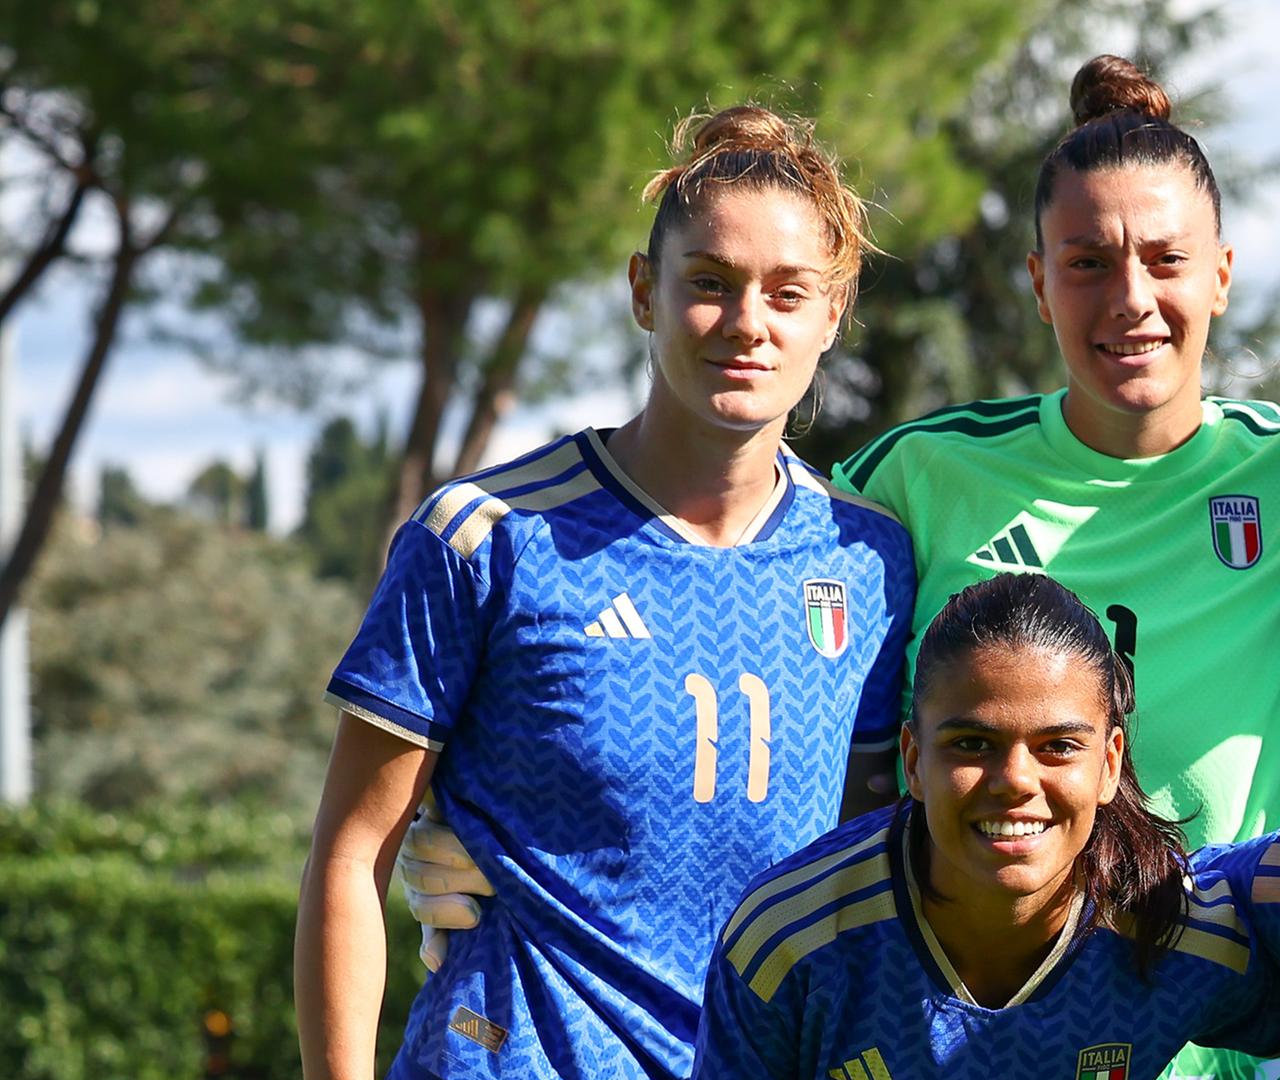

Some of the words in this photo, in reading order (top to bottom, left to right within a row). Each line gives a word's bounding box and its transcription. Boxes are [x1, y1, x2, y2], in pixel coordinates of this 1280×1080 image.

[1213, 501, 1255, 515] ITALIA
[806, 586, 843, 602] ITALIA
[685, 673, 771, 803] 11
[1083, 1049, 1126, 1067] ITALIA
